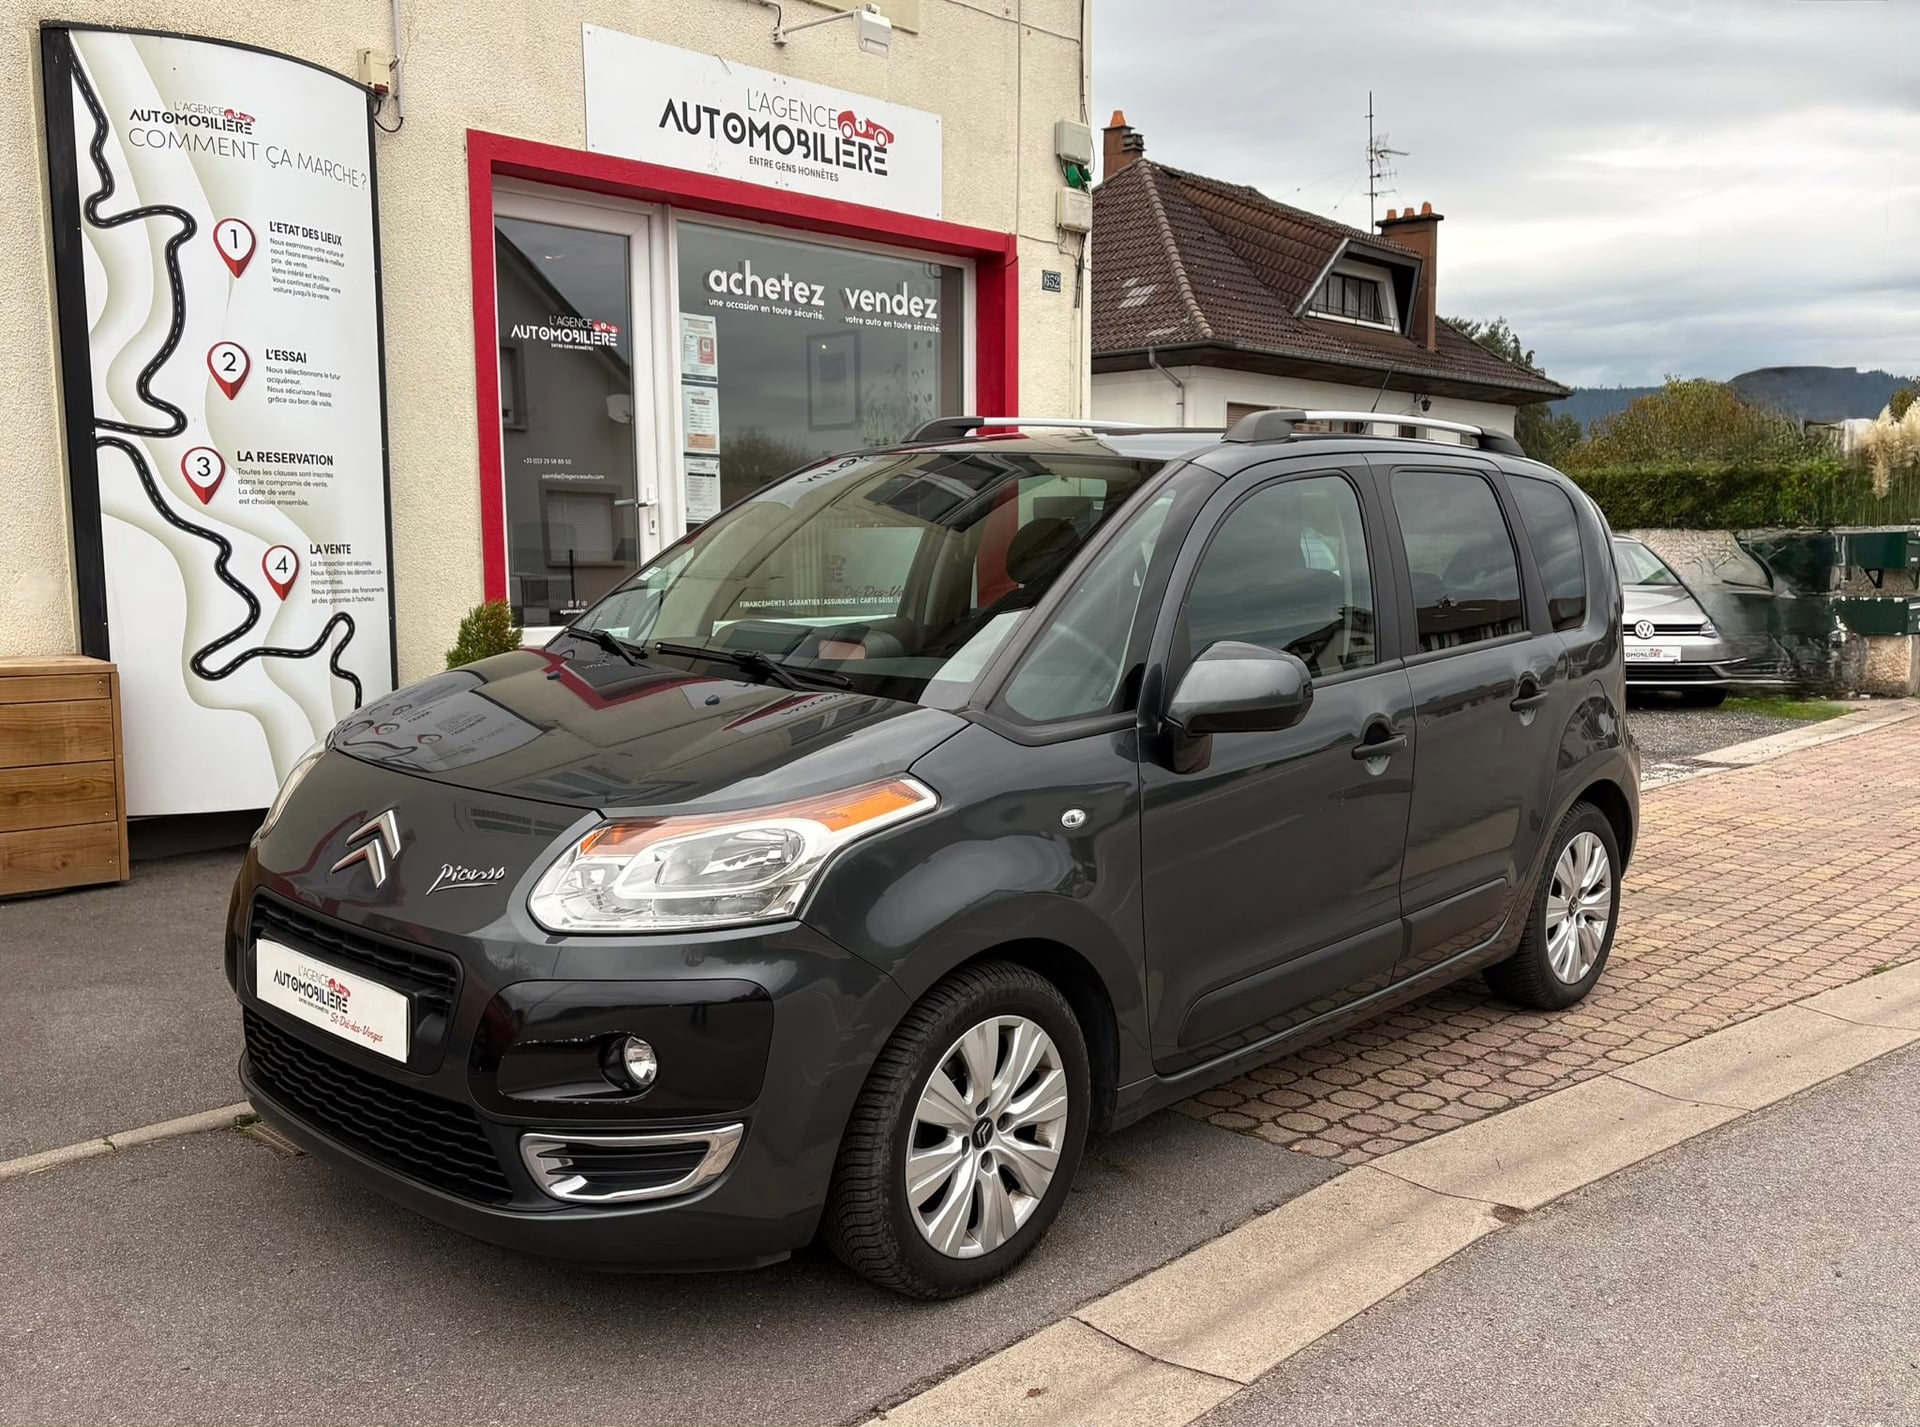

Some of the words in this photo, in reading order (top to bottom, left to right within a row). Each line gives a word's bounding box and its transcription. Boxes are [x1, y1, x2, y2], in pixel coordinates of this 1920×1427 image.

[174, 101, 225, 117] L'AGENCE
[747, 88, 838, 130] L'AGENCE
[129, 128, 260, 161] COMMENT
[265, 145, 293, 168] ÇA
[749, 155, 774, 169] ENTRE
[775, 160, 797, 174] GENS
[230, 229, 238, 249] 1
[269, 220, 300, 236] L'ETAT
[302, 227, 319, 241] DES
[320, 231, 343, 247] LIEUX
[708, 259, 825, 307] achetez
[1044, 273, 1060, 288] 652
[708, 298, 724, 307] une
[726, 300, 759, 312] occasion
[760, 305, 771, 313] en
[772, 305, 792, 316] toute
[794, 307, 825, 320] sécurité.
[844, 281, 938, 320] vendez
[549, 315, 593, 329] L'AGENCE
[845, 316, 863, 326] votre
[865, 317, 882, 327] auto
[883, 319, 893, 328] en
[893, 319, 912, 330] toute
[222, 351, 237, 372] 2
[265, 349, 307, 363] L'ESSAI
[266, 365, 283, 374] Nous
[267, 385, 284, 394] Nous
[196, 456, 212, 477] 3
[237, 450, 254, 462] LA
[257, 451, 334, 466] RESERVATION
[237, 467, 261, 476] Toutes
[262, 468, 272, 476] les
[273, 469, 298, 477] clauses
[238, 478, 256, 486] dans
[238, 487, 247, 495] La
[309, 544, 322, 554] LA
[323, 544, 351, 555] VENTE
[275, 555, 288, 574] 4
[739, 599, 786, 608] FINANCEMENTS
[788, 598, 820, 607] GARANTIES
[823, 597, 857, 605] ASSURANCE
[426, 863, 505, 896] Picasso
[298, 964, 330, 987] L'AGENCE
